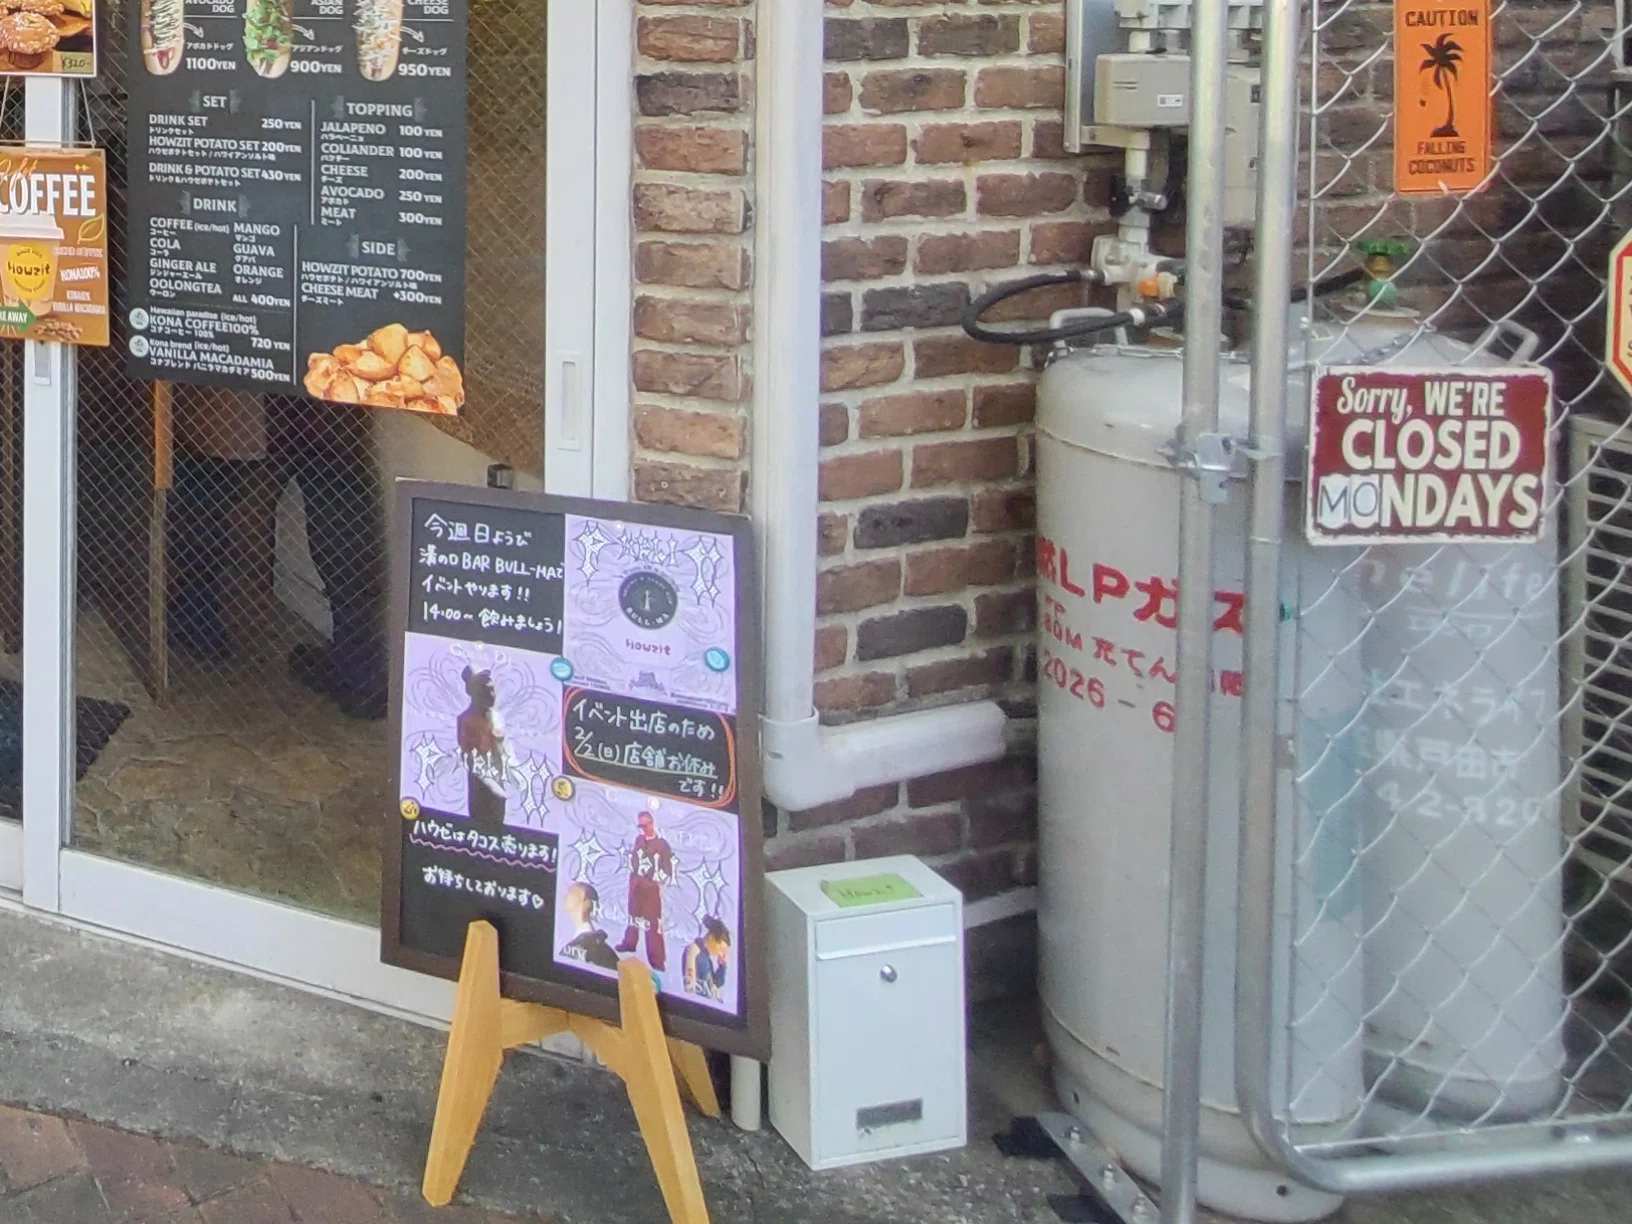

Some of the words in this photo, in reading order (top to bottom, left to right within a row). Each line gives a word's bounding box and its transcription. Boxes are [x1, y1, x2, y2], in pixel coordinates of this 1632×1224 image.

[211, 4, 235, 14] DOG
[318, 5, 344, 16] DOG
[423, 5, 450, 16] DOG
[1404, 9, 1480, 27] CAUTION
[202, 95, 228, 108] SET
[346, 102, 413, 117] TOPPING
[148, 113, 186, 126] DRINK
[187, 115, 209, 127] SET
[260, 118, 284, 130] 250
[284, 121, 302, 131] YEN
[320, 121, 387, 135] JALAPENO
[398, 124, 423, 137] 100
[424, 128, 443, 138] YEN
[149, 135, 193, 148] HOWZIT
[193, 137, 238, 151] POTATO
[239, 140, 261, 152] SET
[320, 142, 396, 157] COLIANDER
[398, 146, 423, 159] 100
[424, 150, 443, 160] YEN
[1416, 140, 1467, 155] FALLING
[148, 162, 184, 175] DRINK
[194, 165, 240, 179] POTATO
[240, 167, 261, 179] SET
[283, 172, 302, 182] YEN
[320, 164, 369, 177] CHEESE
[1407, 157, 1477, 175] COCONUTS
[320, 185, 386, 200] AVOCADO
[398, 190, 423, 202] 250
[423, 194, 443, 204] YEN
[193, 197, 237, 213] DRINK
[320, 206, 357, 219] MEAT
[149, 216, 194, 230] COFFEE
[233, 221, 281, 236] MANGO
[149, 237, 182, 250] COLA
[233, 243, 276, 257] GUAVA
[361, 241, 396, 256] SIDE
[7, 259, 51, 276] Howzit
[149, 257, 194, 272] GINGER
[194, 261, 217, 274] ALE
[233, 263, 285, 279] ORANGE
[301, 260, 349, 276] HOWZIT
[351, 264, 399, 280] POTATO
[149, 277, 223, 294] OOLONGTEA
[301, 282, 345, 297] CHEESE
[345, 286, 379, 300] MEAT
[232, 293, 248, 304] ALL
[8, 310, 28, 325] AWAY
[150, 306, 185, 318] Hawaiian
[149, 315, 184, 329] KONA
[149, 338, 170, 348] Kona
[250, 337, 273, 350] 720
[272, 341, 291, 351] YEN
[149, 346, 198, 362] VANILLA
[199, 352, 275, 370] MACADAMIA
[1336, 375, 1414, 425] Sorry,
[1423, 380, 1508, 417] WE'RE
[1341, 418, 1521, 471] CLOSED
[1318, 473, 1539, 529] MONDAYS
[424, 513, 532, 547] 今週日ようび
[461, 552, 491, 573] BAR
[572, 698, 716, 742] イベント出店のため
